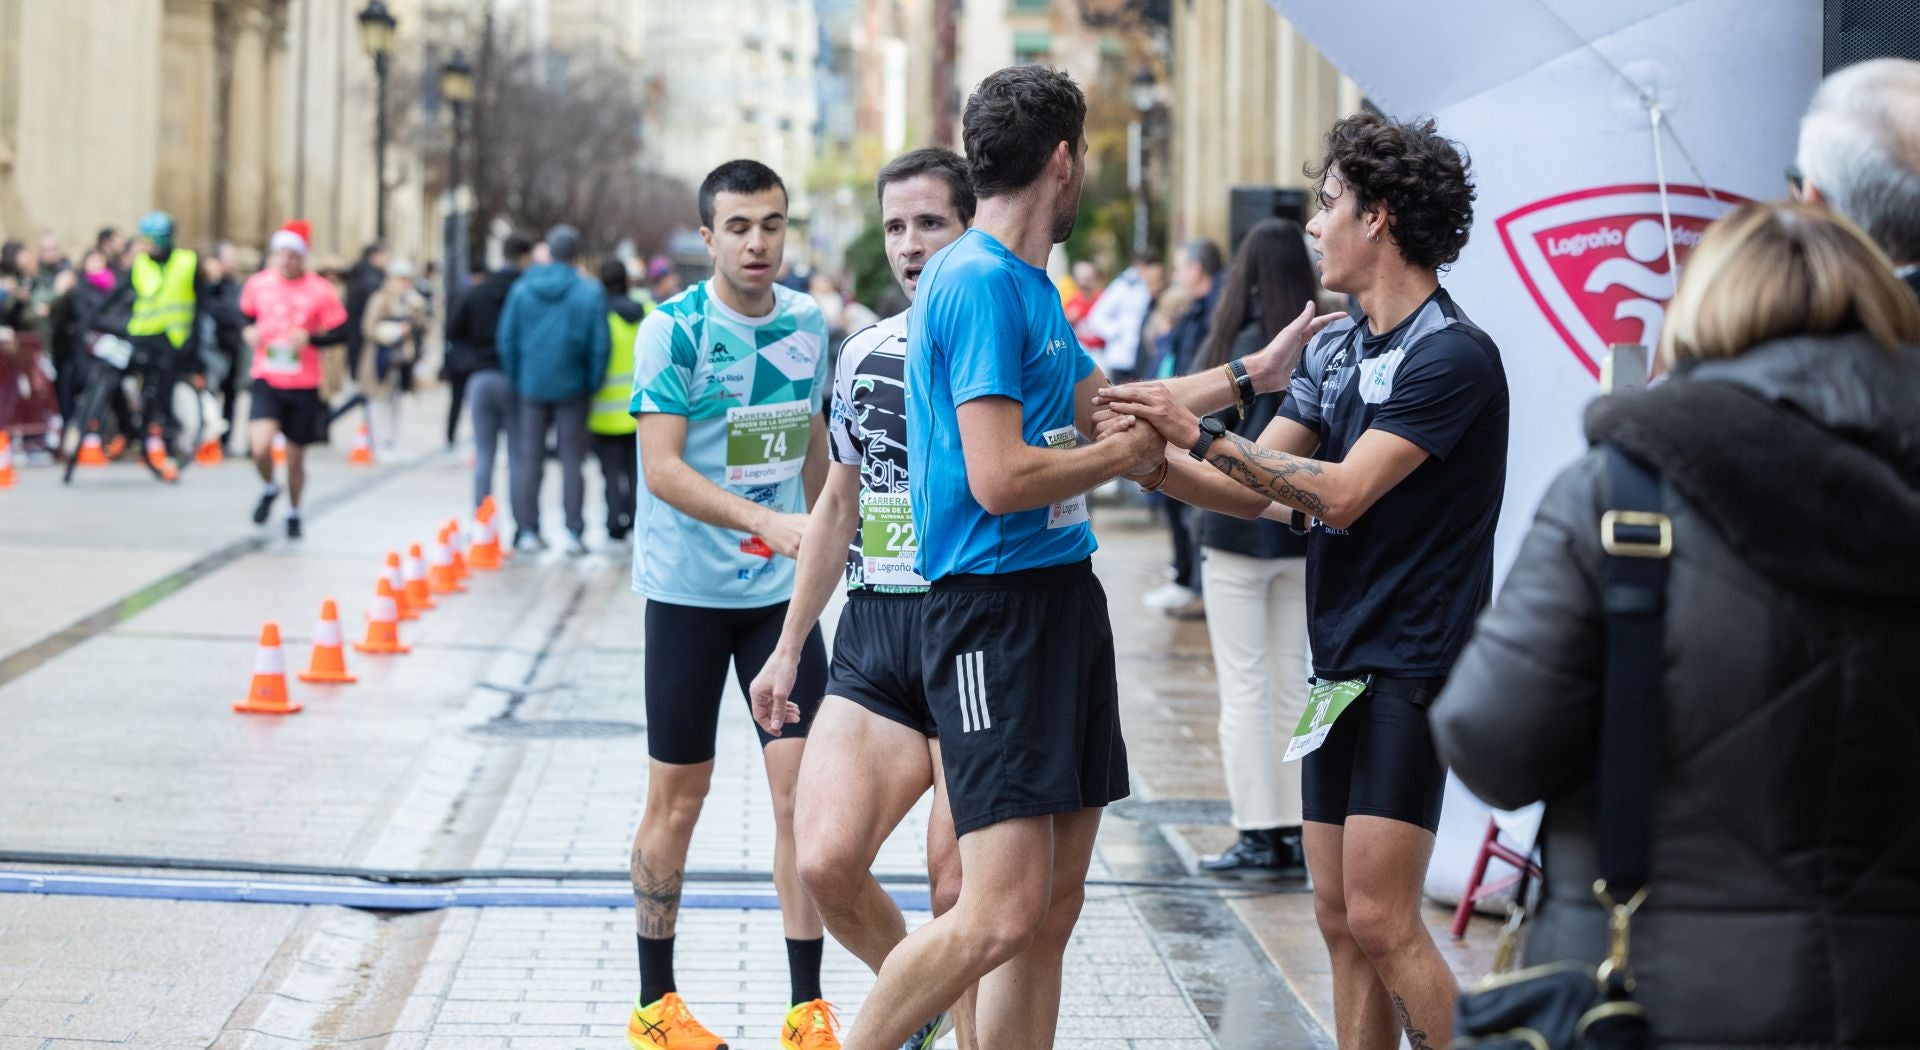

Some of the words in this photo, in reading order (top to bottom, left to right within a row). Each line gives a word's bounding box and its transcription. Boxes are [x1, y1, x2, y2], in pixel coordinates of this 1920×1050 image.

[1546, 226, 1623, 257] Logroño
[726, 373, 743, 382] Rioja
[731, 410, 773, 421] CARRERA
[775, 406, 809, 418] POPULAR
[734, 420, 758, 428] VIRGEN
[769, 418, 777, 426] LA
[761, 431, 788, 459] 74
[744, 468, 777, 479] Logroño
[867, 497, 909, 506] CARRERA
[868, 506, 891, 514] VIRGEN
[891, 506, 902, 514] DE
[877, 562, 912, 573] Logroño
